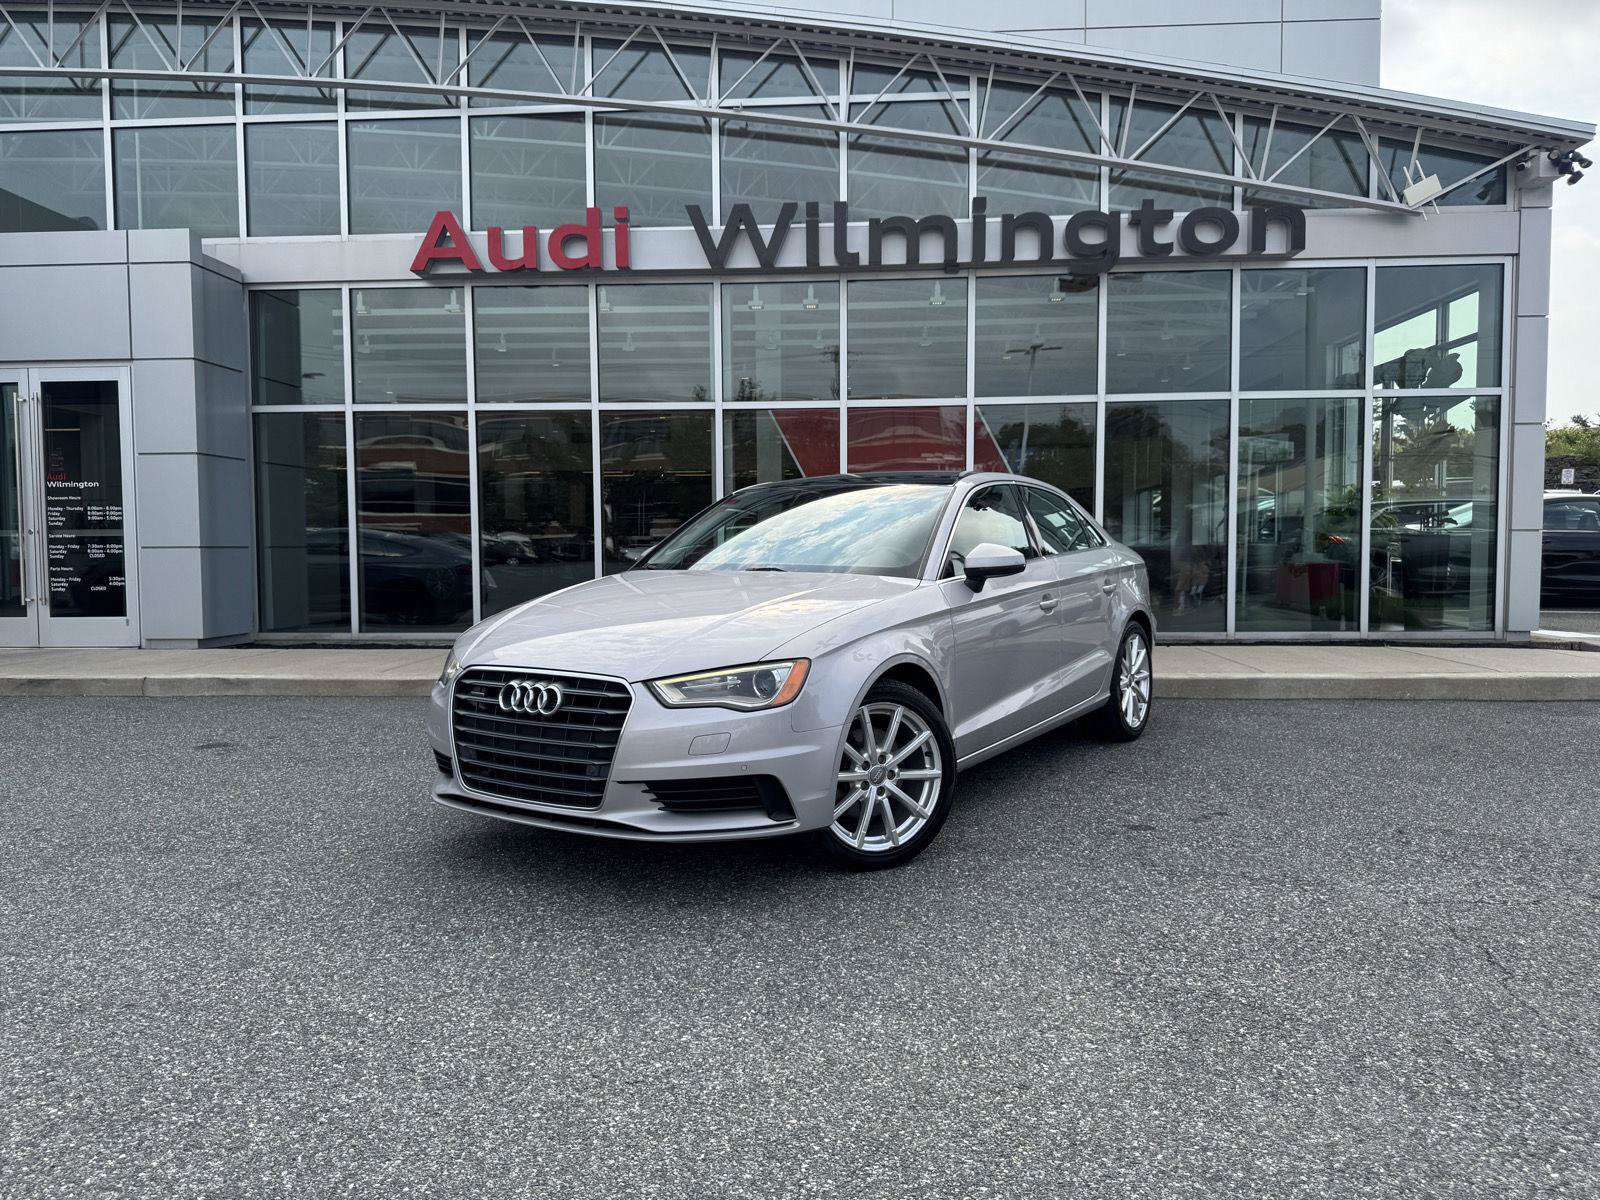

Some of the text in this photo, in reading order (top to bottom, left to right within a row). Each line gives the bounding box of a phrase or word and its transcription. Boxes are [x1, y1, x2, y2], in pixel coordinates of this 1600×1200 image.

[410, 197, 1306, 277] Audi Wilmington
[47, 472, 66, 480] Audi
[46, 481, 99, 489] Wilmington
